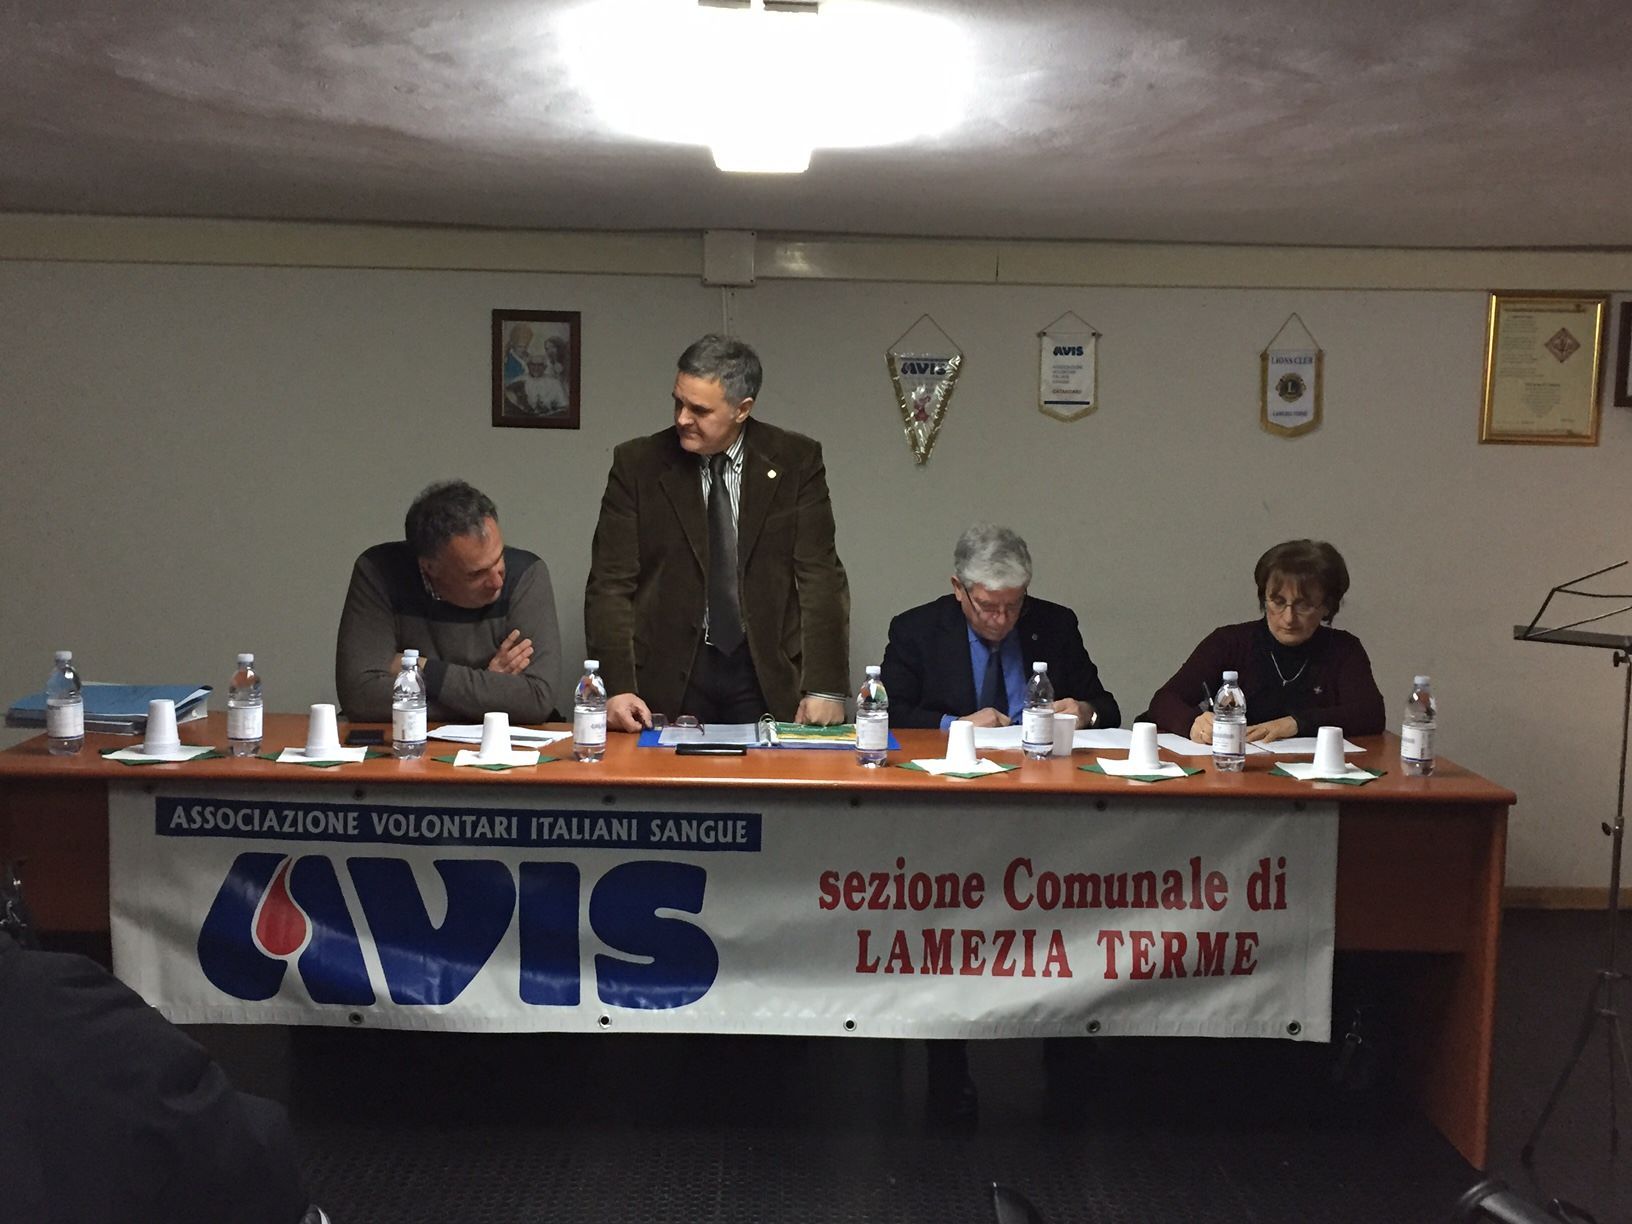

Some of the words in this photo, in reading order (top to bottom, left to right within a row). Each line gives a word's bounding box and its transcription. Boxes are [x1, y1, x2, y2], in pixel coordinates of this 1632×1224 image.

[901, 362, 946, 375] AVIS
[1053, 346, 1084, 356] AVIS
[169, 805, 360, 836] ASSOCIAZIONE
[371, 813, 519, 840] VOLONTARI
[530, 816, 638, 842] ITALIANI
[649, 818, 748, 844] SANGUE
[818, 856, 986, 911] sezione
[1003, 856, 1230, 912] Comunale
[1246, 856, 1288, 911] di
[197, 852, 720, 1010] AVIS
[855, 928, 1074, 978] LAMEZIA
[1096, 929, 1261, 980] TERME
